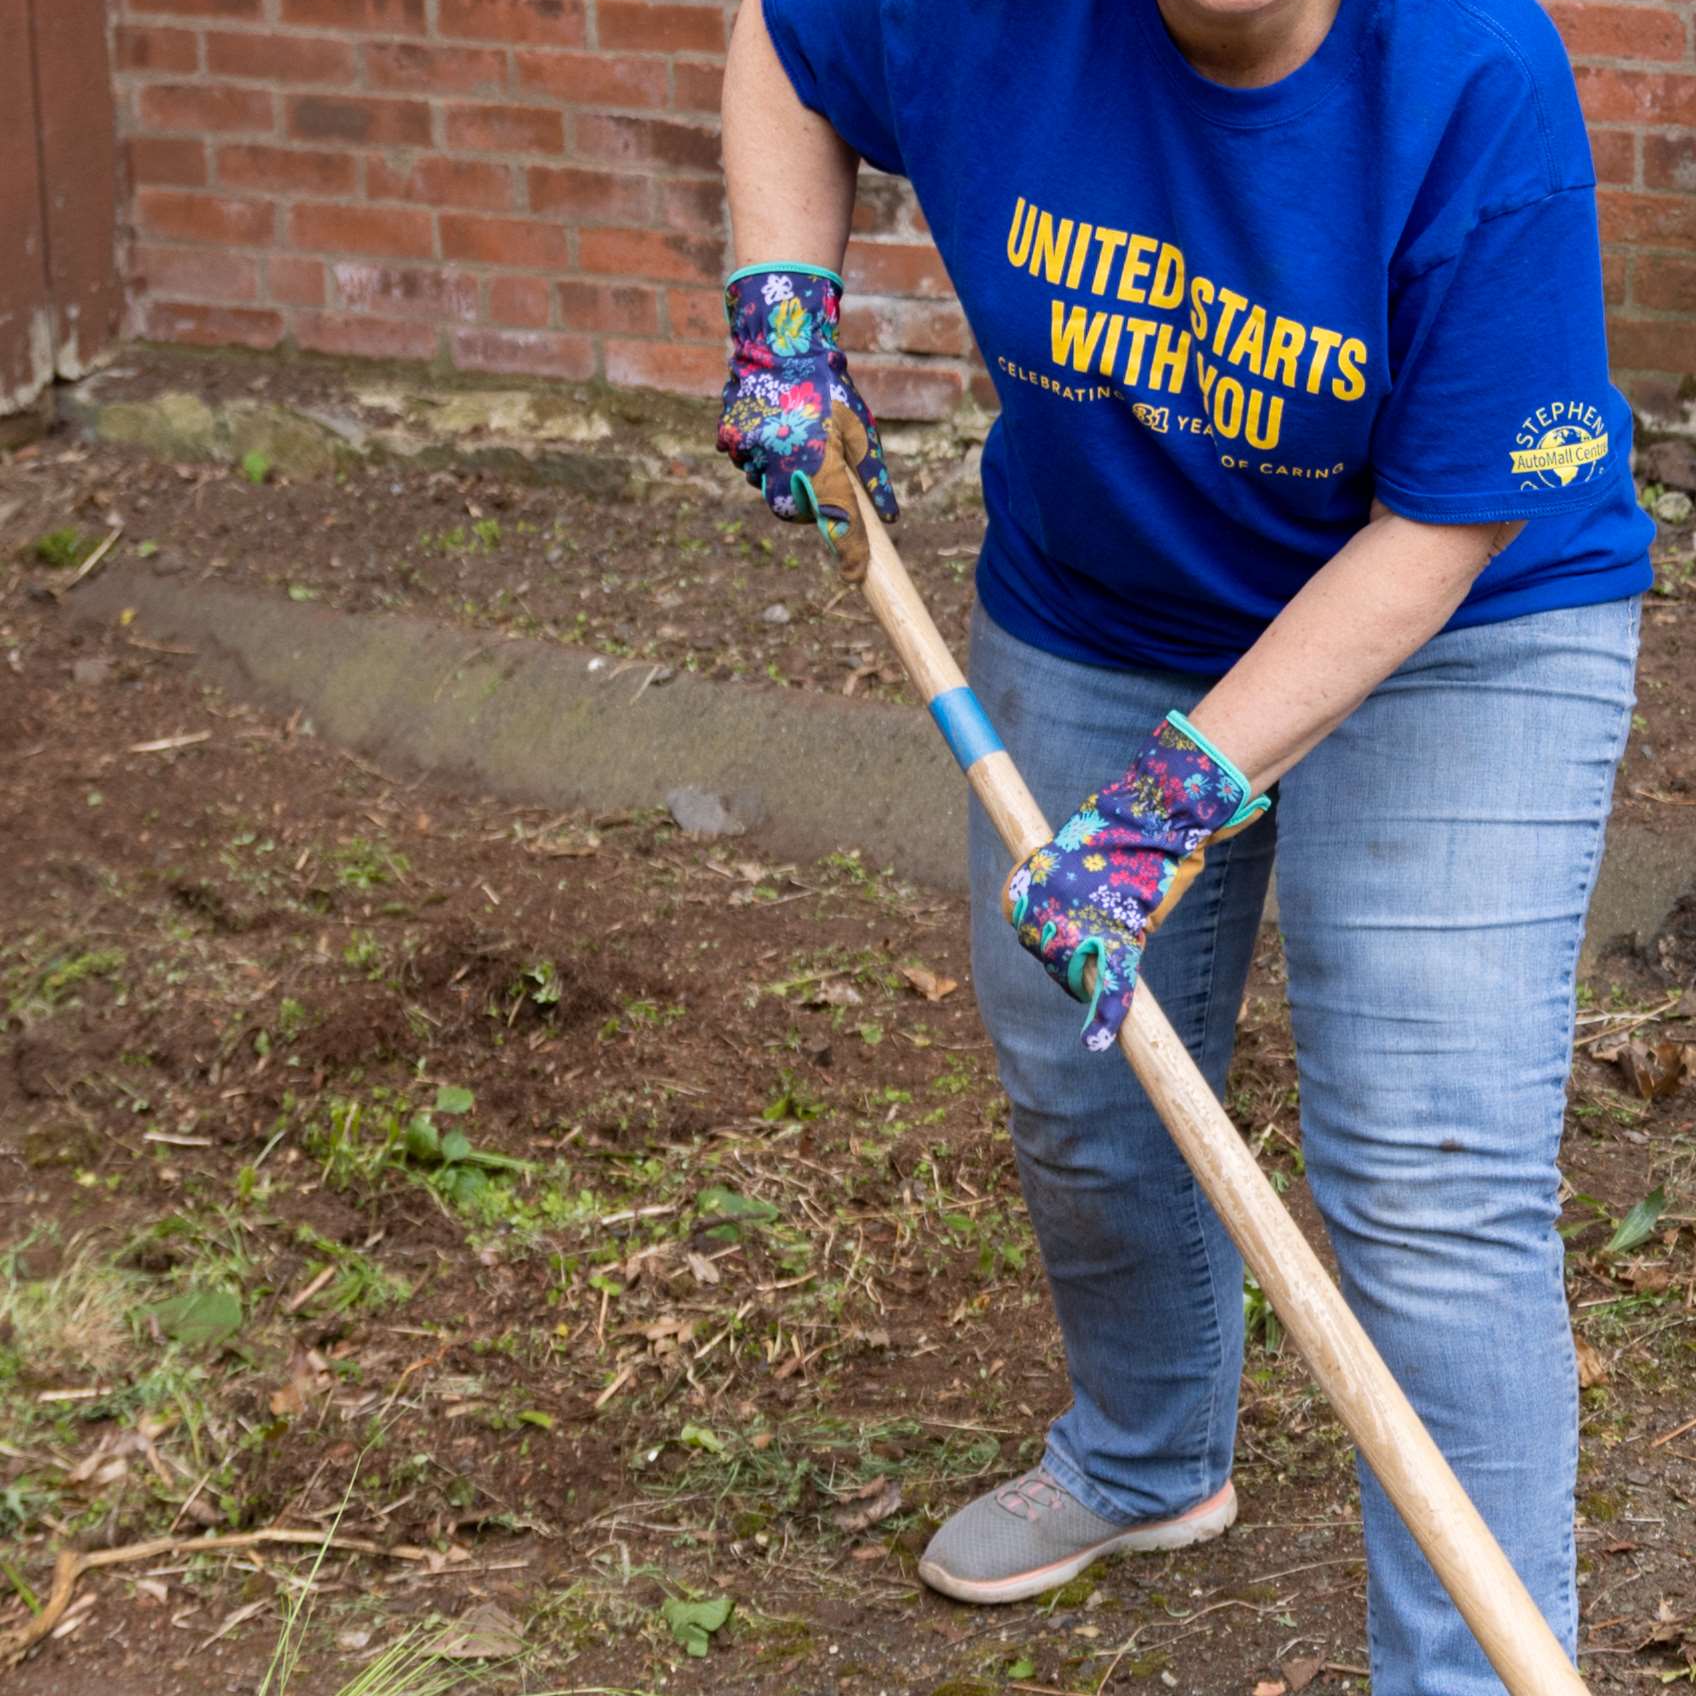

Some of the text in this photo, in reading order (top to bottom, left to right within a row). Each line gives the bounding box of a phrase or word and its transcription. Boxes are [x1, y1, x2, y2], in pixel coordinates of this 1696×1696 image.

[1007, 197, 1368, 402] UNITED STARTS
[1050, 299, 1285, 451] WITH YOU
[1177, 415, 1217, 447] YEA
[1221, 455, 1249, 471] OF
[1260, 462, 1344, 479] CARING
[1515, 401, 1605, 448] STEPHEN
[1517, 447, 1573, 470] AutoMall
